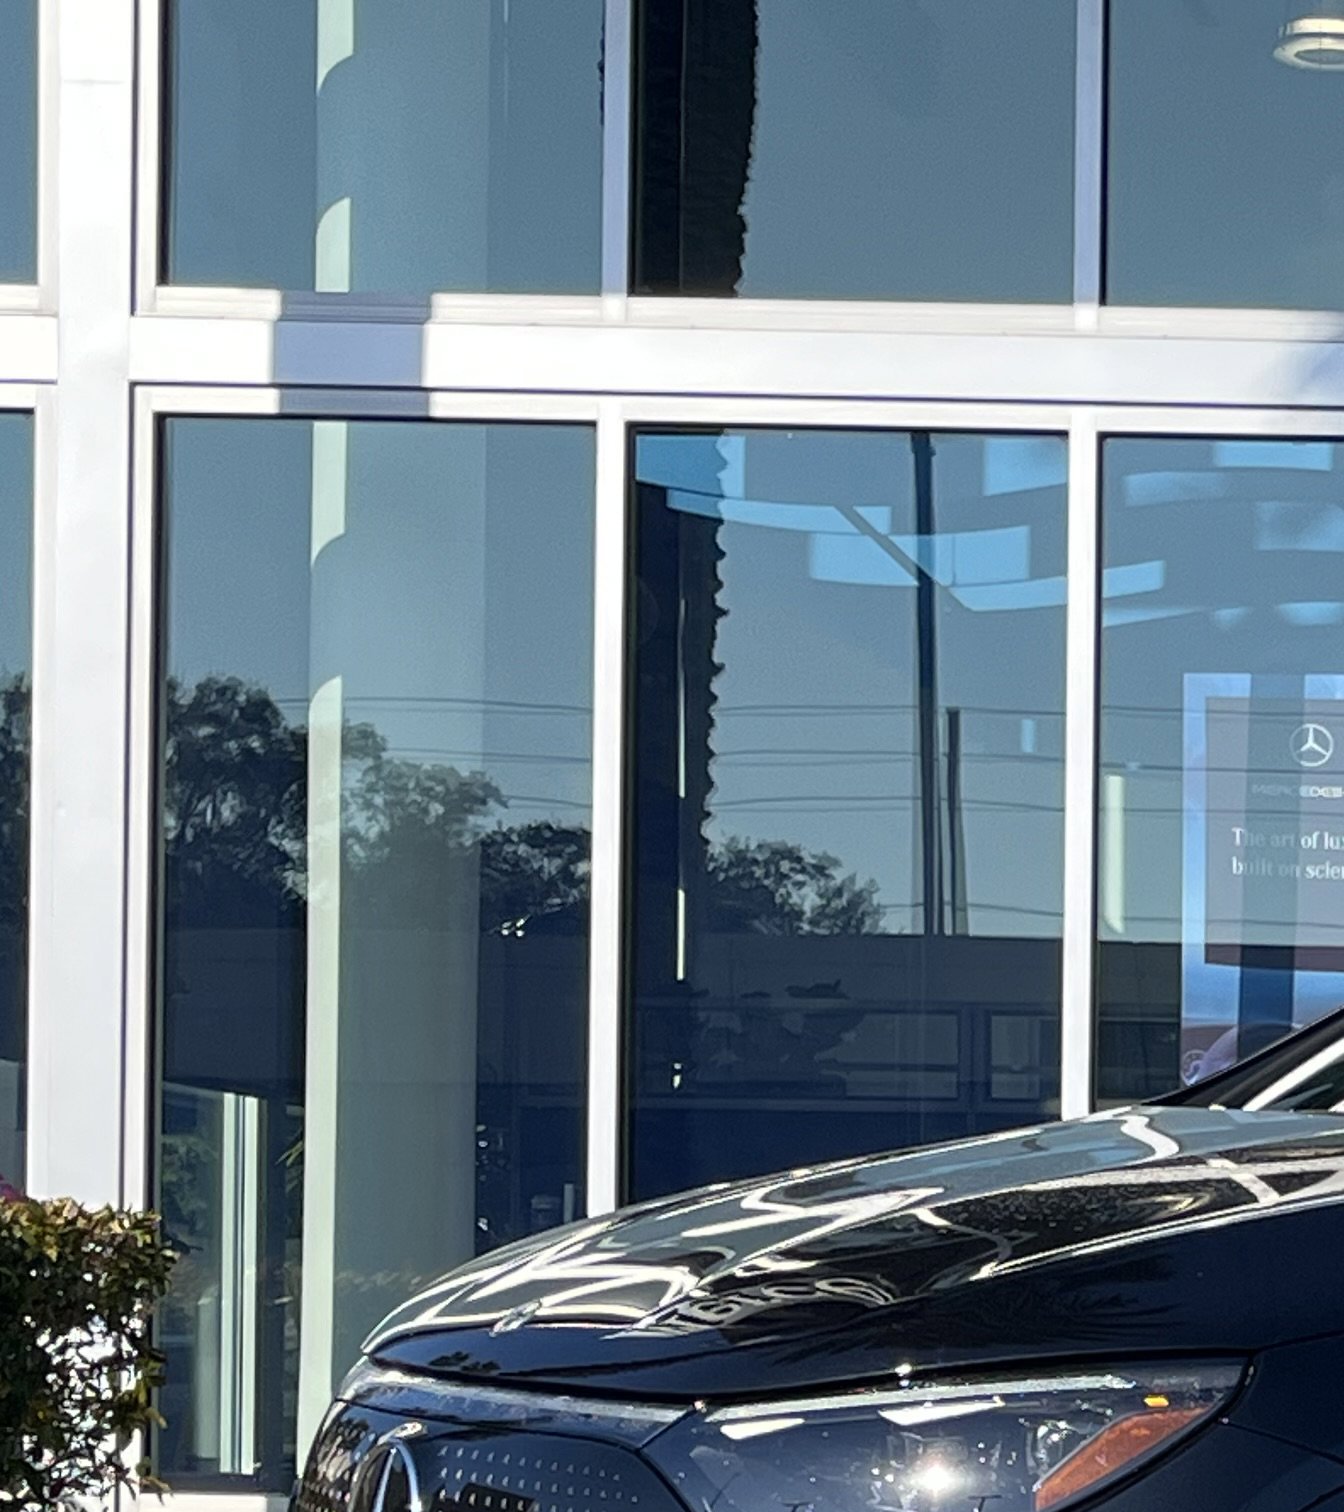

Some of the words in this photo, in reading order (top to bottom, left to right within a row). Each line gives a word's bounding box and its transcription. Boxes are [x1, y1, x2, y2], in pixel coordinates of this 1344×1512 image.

[1231, 827, 1266, 848] The
[1270, 832, 1297, 849] art
[1300, 830, 1321, 850] of
[1231, 855, 1273, 876] built
[1278, 863, 1300, 879] on
